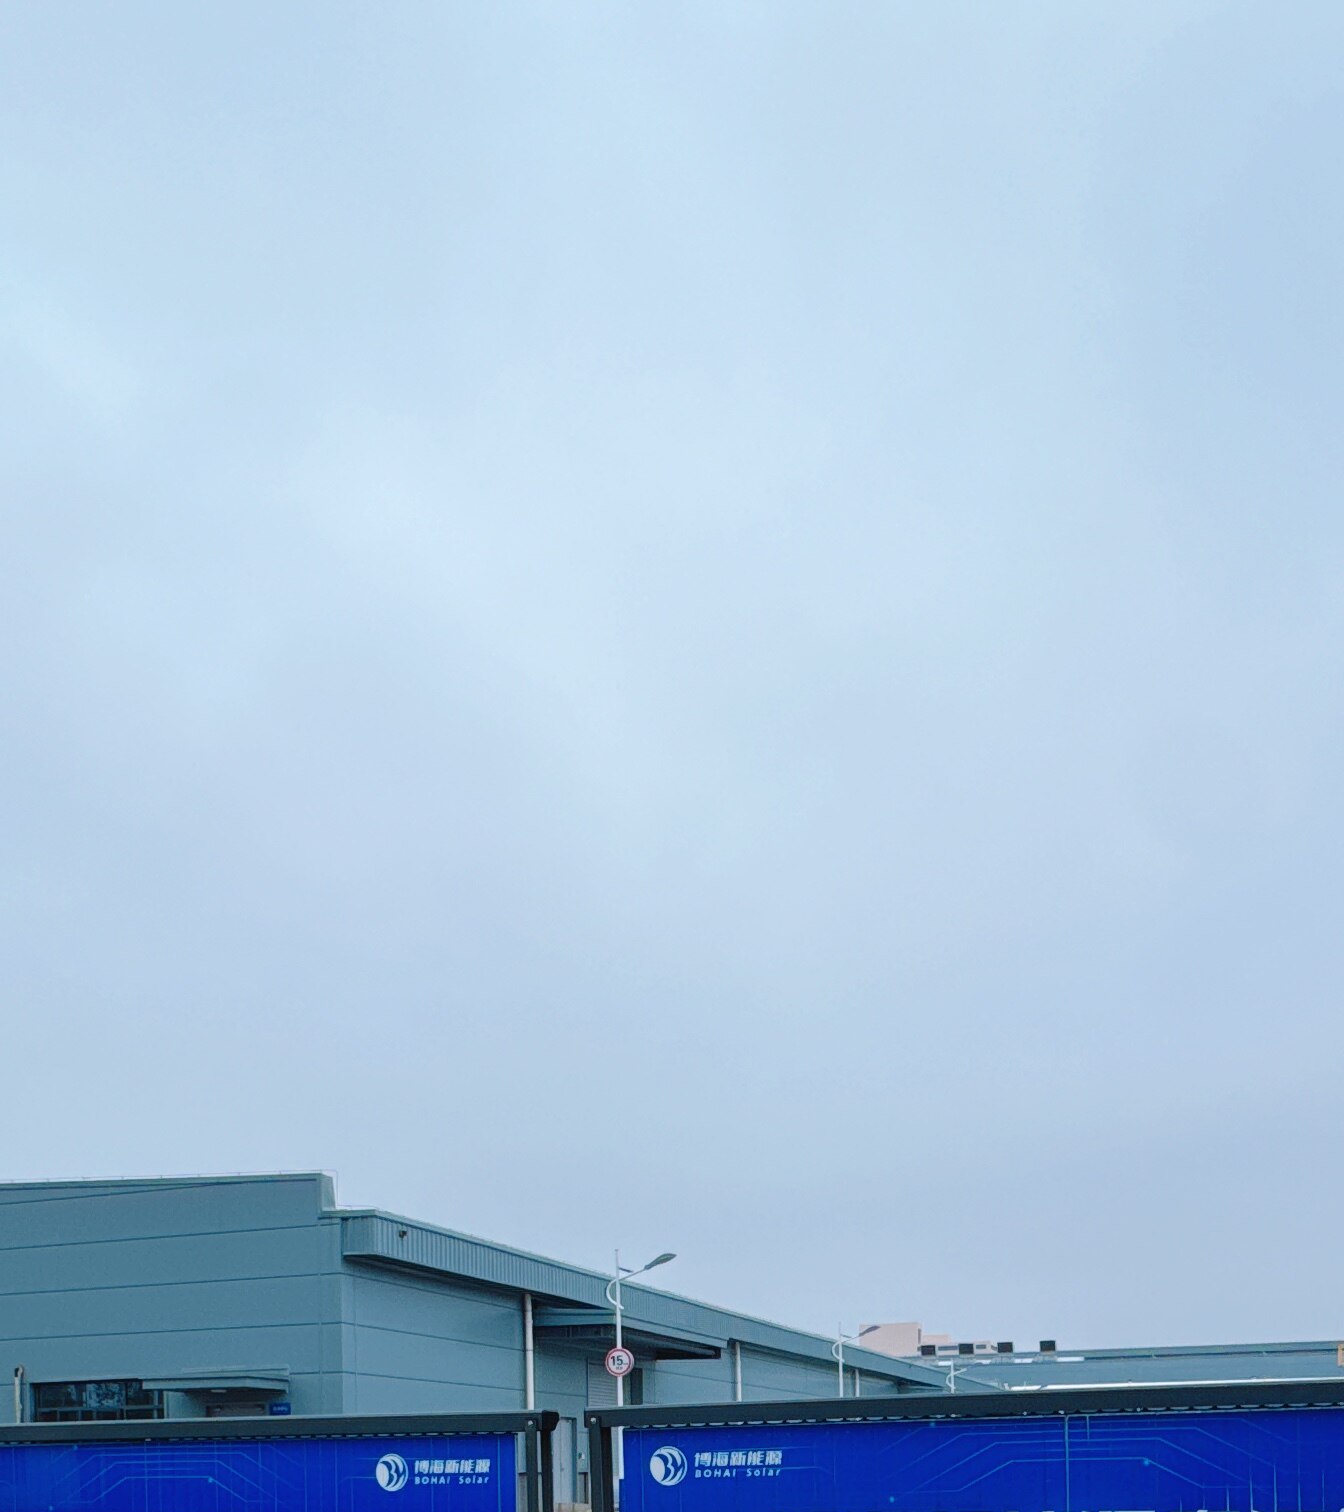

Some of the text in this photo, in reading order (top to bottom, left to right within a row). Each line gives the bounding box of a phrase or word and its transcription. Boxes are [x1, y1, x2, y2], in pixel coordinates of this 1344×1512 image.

[611, 1355, 623, 1366] 15
[694, 1450, 783, 1467] 博海新能源
[414, 1458, 491, 1474] 博海新能源
[695, 1468, 781, 1478] BOHAI Solar
[414, 1475, 489, 1485] BOHAI Solar
